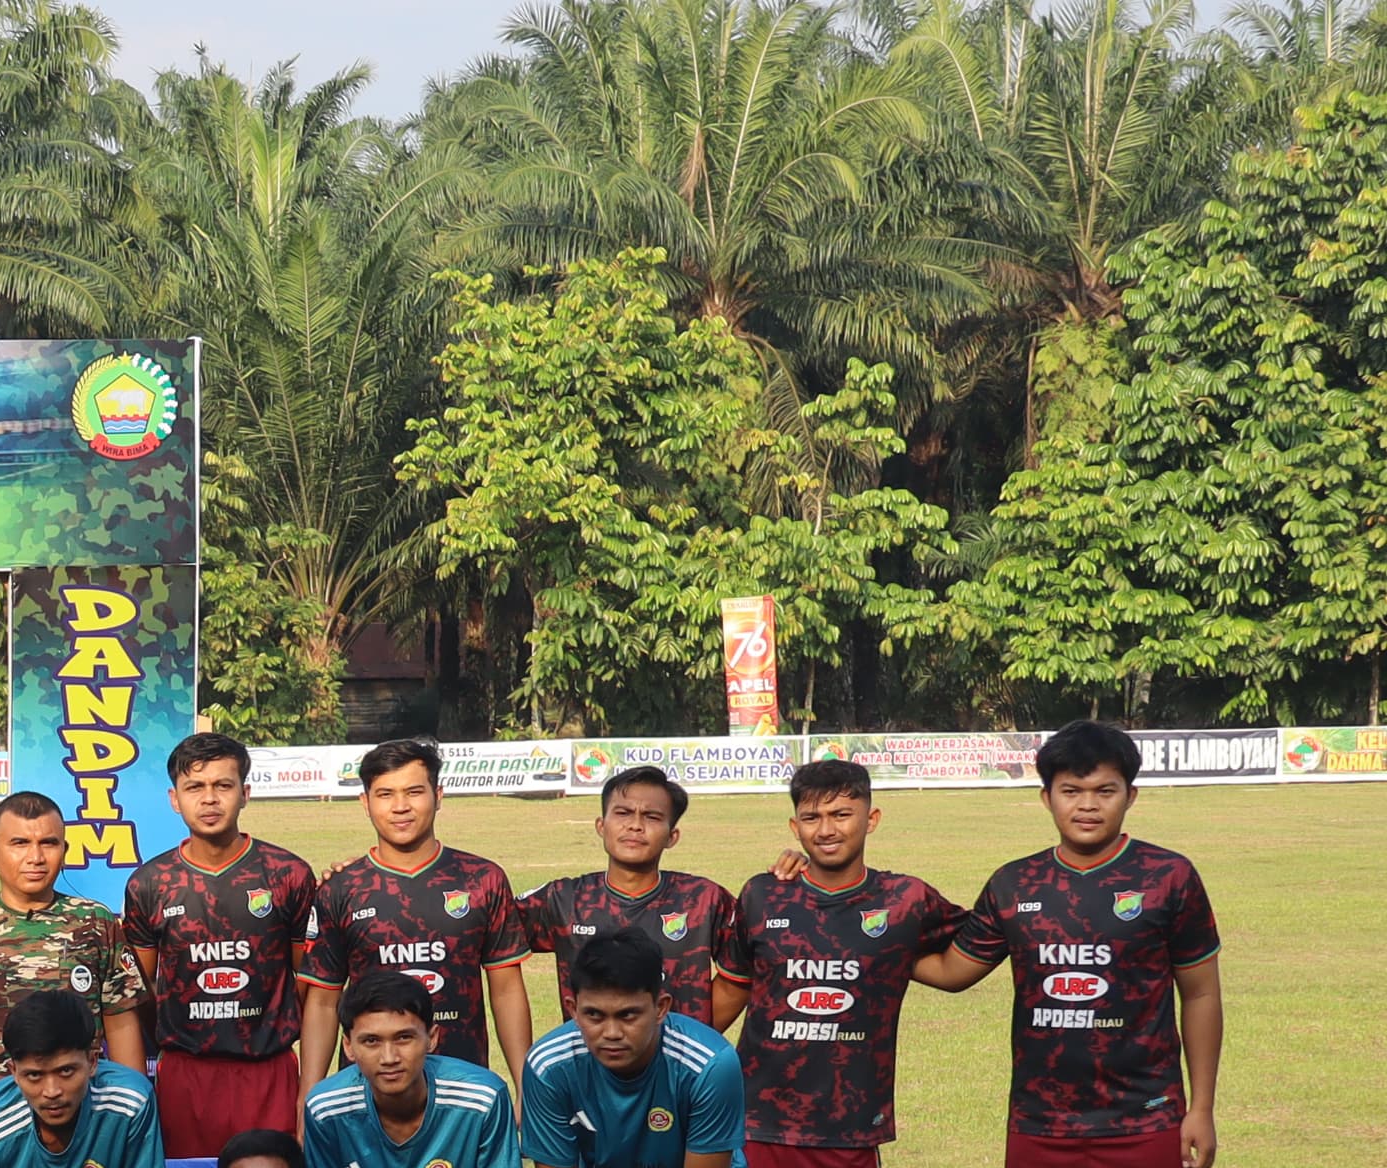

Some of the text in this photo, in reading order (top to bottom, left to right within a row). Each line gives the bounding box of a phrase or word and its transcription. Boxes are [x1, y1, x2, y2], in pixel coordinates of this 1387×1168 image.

[729, 621, 768, 669] 76
[728, 678, 775, 693] APEL
[734, 694, 770, 706] ROYAL
[886, 738, 1004, 750] WADAH KERJASAMA
[449, 748, 475, 757] 5115
[626, 746, 786, 763] KUD FLAMBOYAN
[852, 753, 892, 764] ANTAR
[894, 752, 957, 764] KELOMPOK
[959, 751, 989, 763] TANI
[1168, 736, 1277, 772] FLAMBOYAN
[454, 759, 495, 773] AGRI
[498, 756, 564, 774] PASIFIK
[908, 765, 980, 777] FLAMBOYAN
[278, 770, 327, 782] MOBIL
[685, 765, 795, 779] SEJAHTERA
[438, 775, 525, 788] CAVATOR RIAU
[163, 905, 185, 918] K99
[351, 907, 377, 921] K99
[1017, 902, 1042, 913] K99
[572, 924, 596, 936] K99
[765, 918, 790, 929] K99
[189, 940, 251, 963] KNES
[378, 940, 447, 965] KNES
[1038, 943, 1112, 966] KNES
[786, 959, 861, 982] KNES
[239, 1007, 263, 1018] RIAU
[433, 1010, 459, 1021] RIAU
[1032, 1008, 1124, 1029] APDESI RIAU
[771, 1020, 866, 1042] APDESI RIAU
